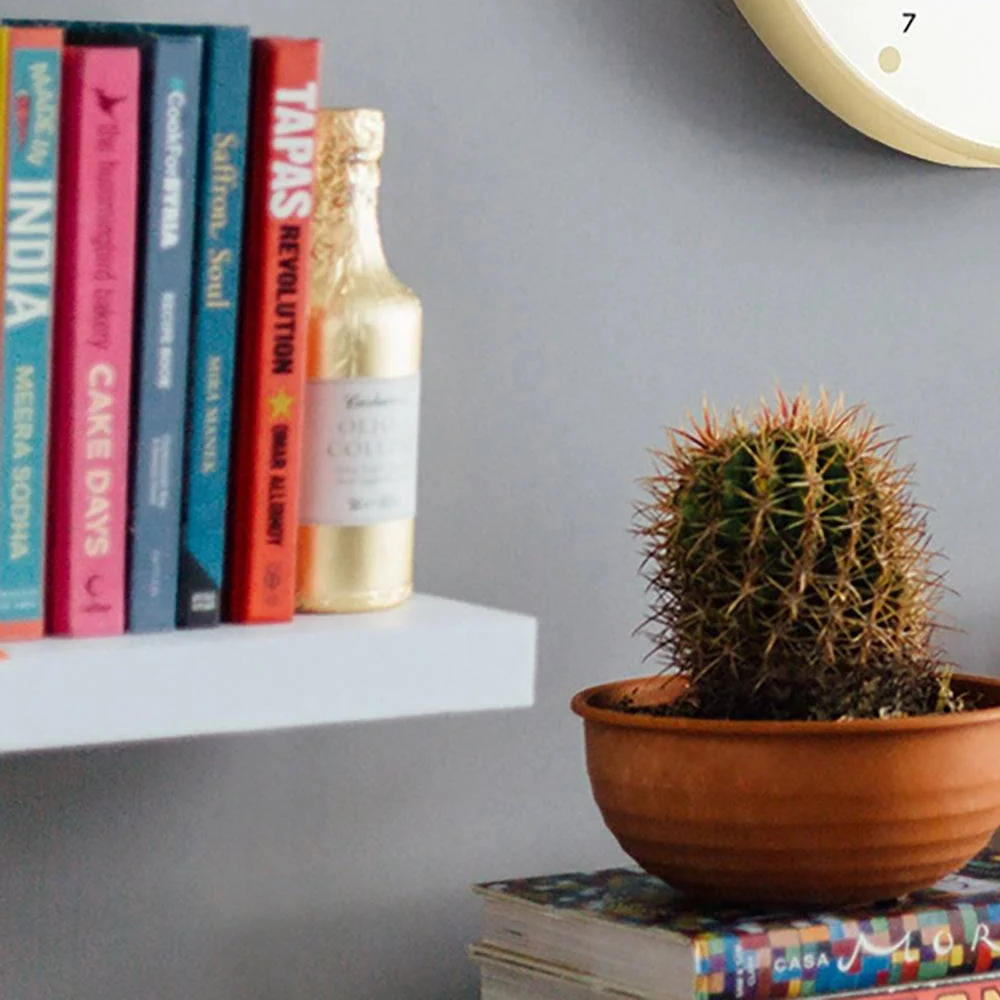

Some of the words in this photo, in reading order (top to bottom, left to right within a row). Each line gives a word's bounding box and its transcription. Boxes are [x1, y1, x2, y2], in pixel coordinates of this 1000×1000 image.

[902, 12, 917, 34] 7
[208, 131, 239, 239] Saffron
[269, 81, 319, 219] TAPAS
[4, 179, 54, 328] INDIA
[205, 247, 231, 310] Soul
[272, 224, 300, 375] REVOLUTION
[11, 364, 35, 460] MEERA
[85, 363, 116, 460] CAKE
[8, 465, 33, 560] SODHA
[83, 466, 113, 557] DAYS
[774, 952, 830, 973] CASA
